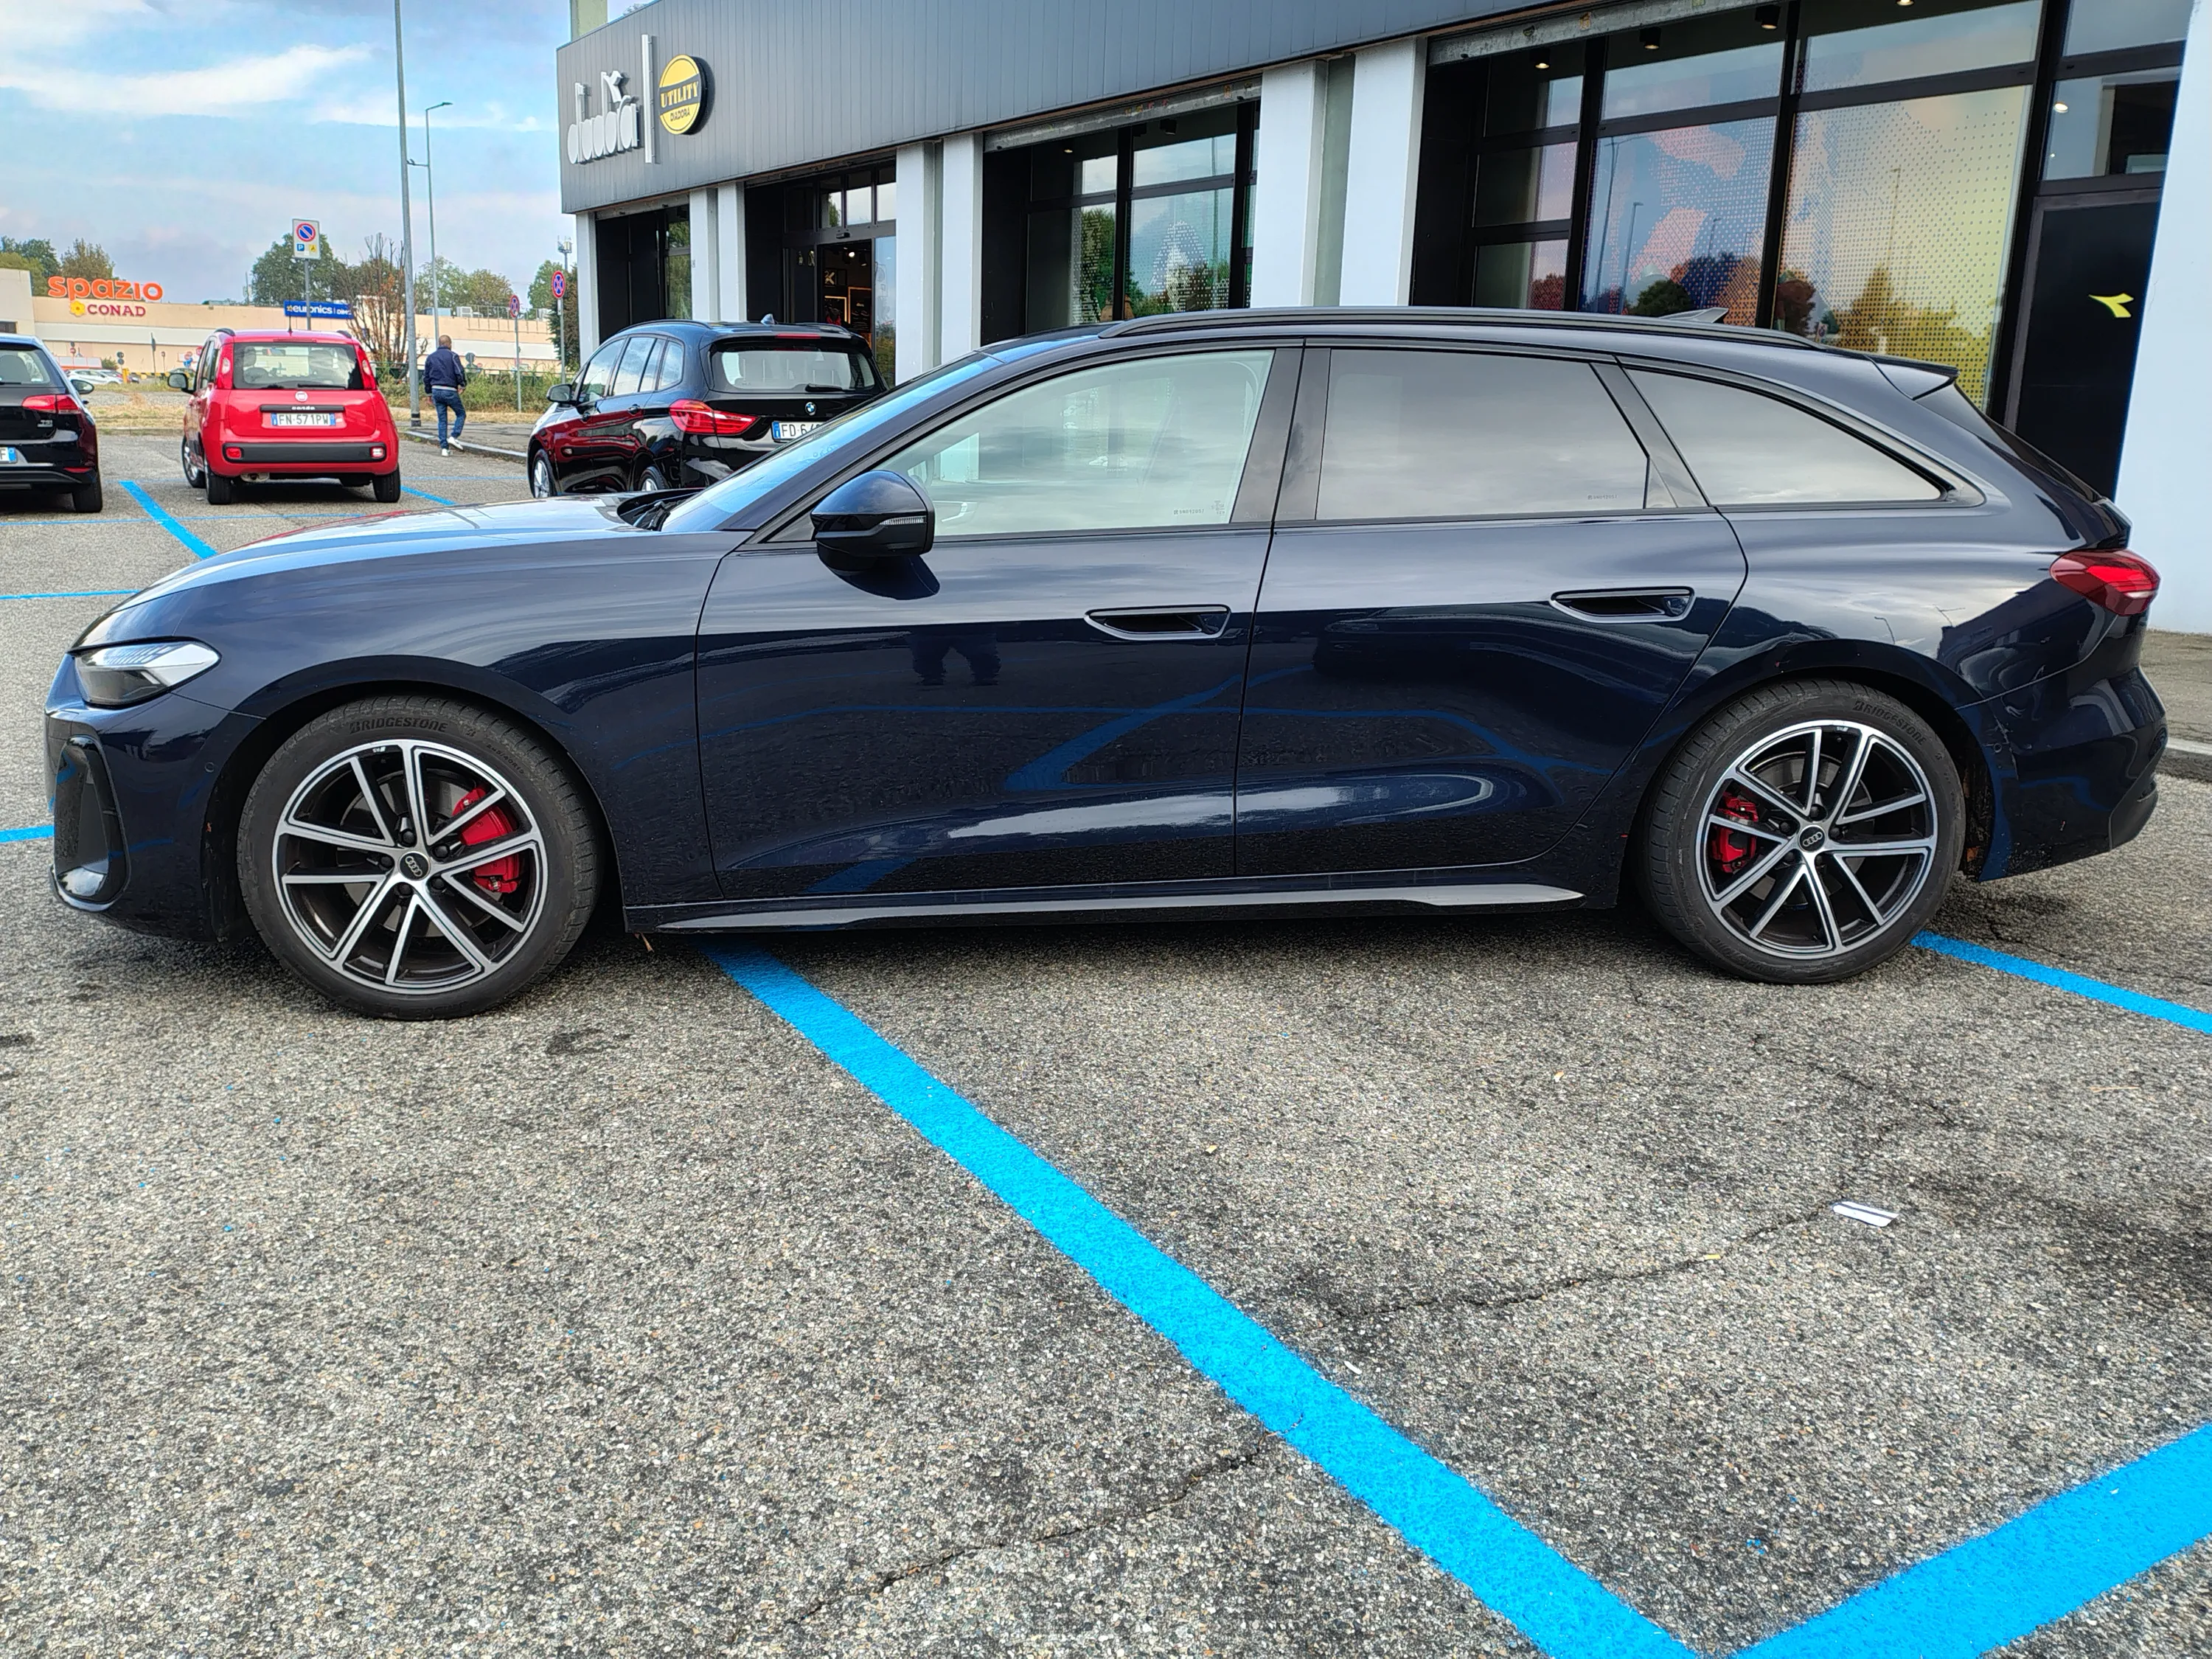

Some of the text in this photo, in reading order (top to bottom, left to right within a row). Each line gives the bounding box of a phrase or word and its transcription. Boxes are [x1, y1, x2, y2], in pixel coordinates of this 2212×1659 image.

[660, 81, 699, 108] UTILITY
[670, 107, 690, 122] DIADORA
[48, 276, 164, 302] spazio
[87, 304, 147, 317] CONAD
[349, 717, 448, 734] BRIDGESTONE
[1852, 700, 1927, 746] BRIDGESTONE
